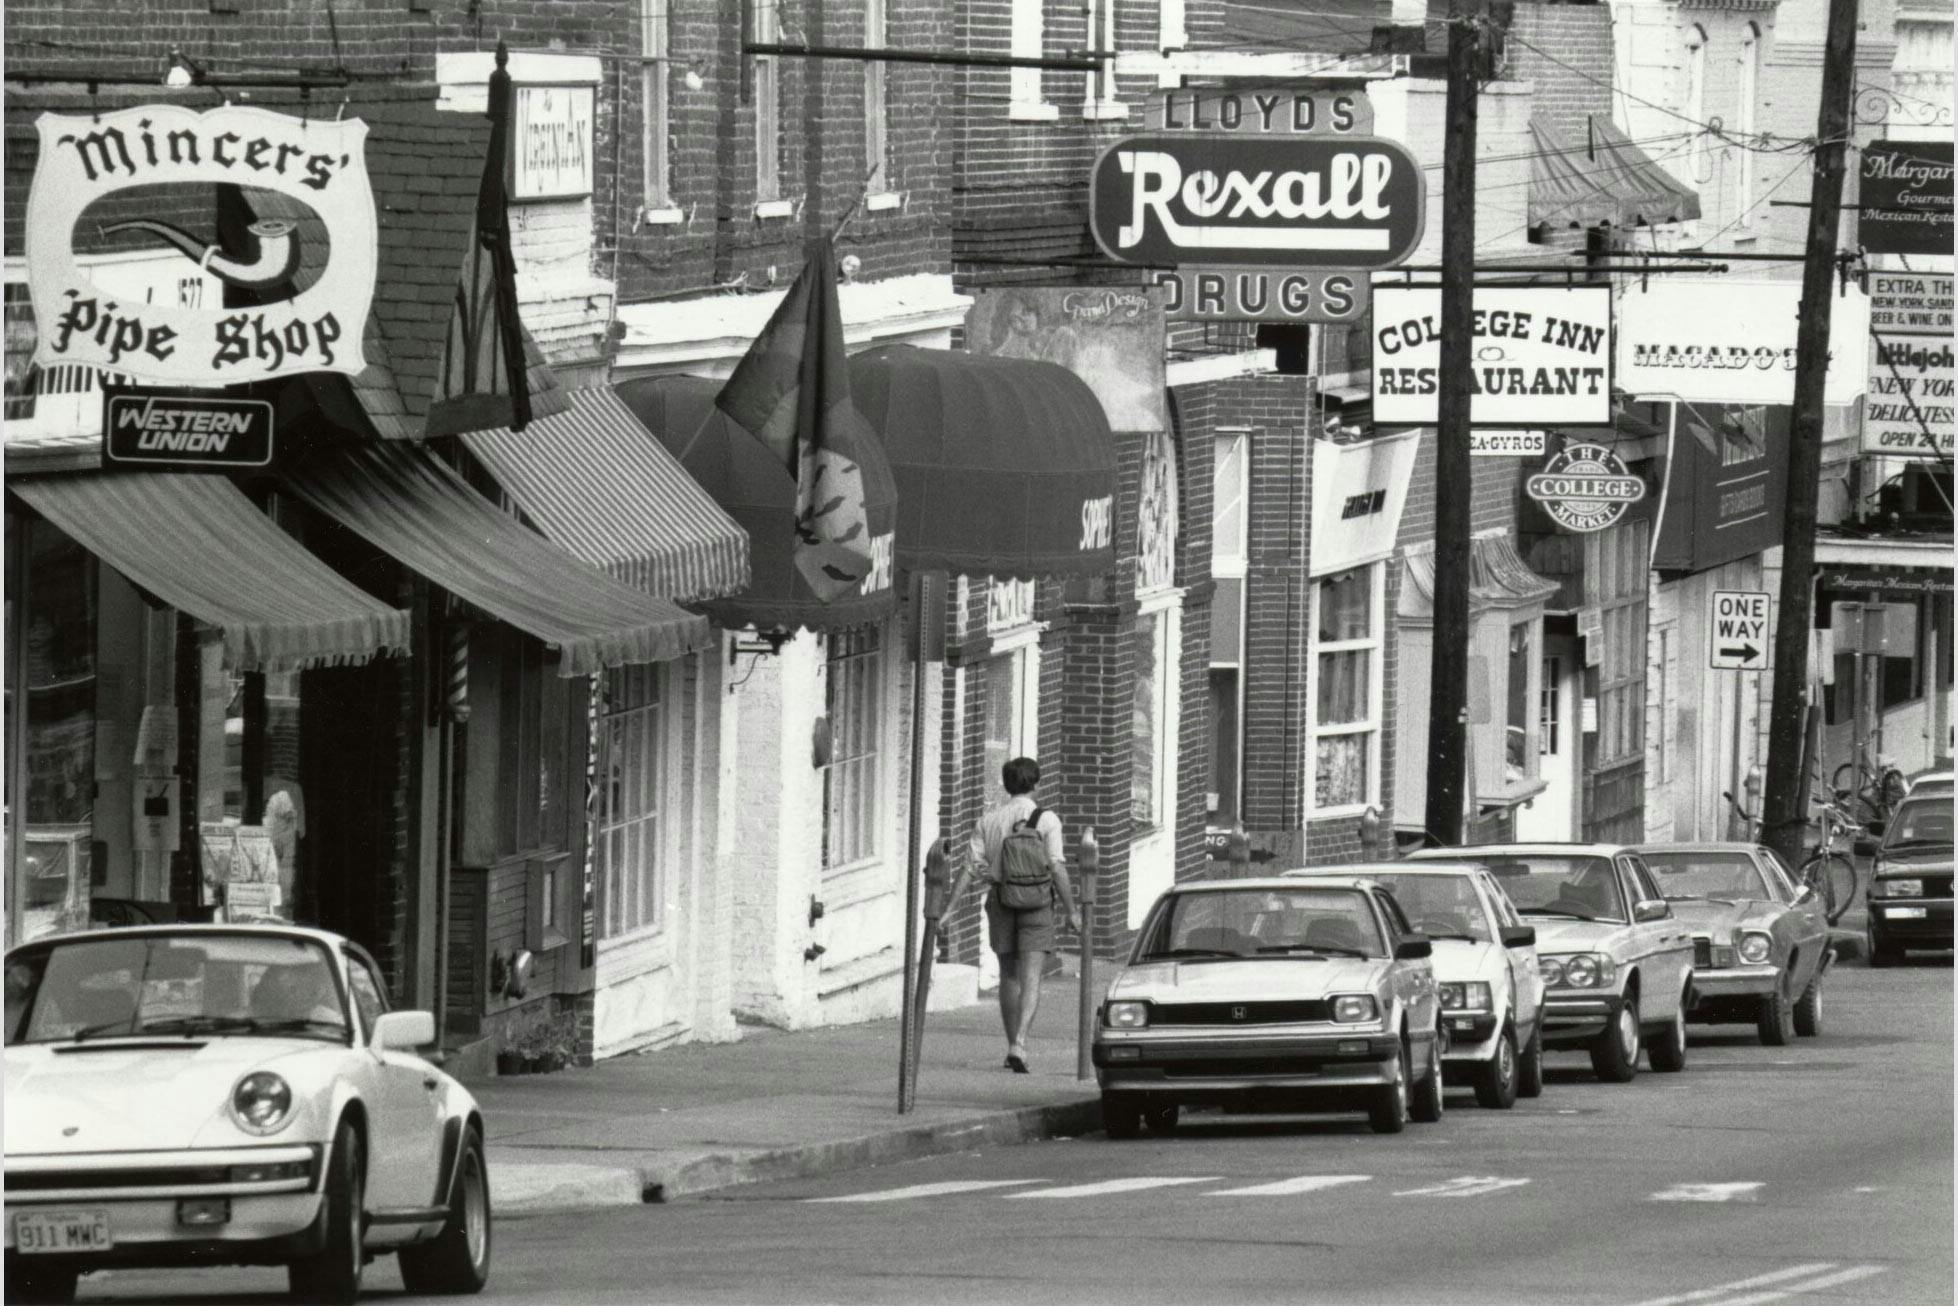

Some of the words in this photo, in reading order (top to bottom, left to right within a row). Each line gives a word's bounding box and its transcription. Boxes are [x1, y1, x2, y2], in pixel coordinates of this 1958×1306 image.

[1163, 94, 1356, 133] LLOYDS
[1117, 151, 1393, 250] Rexall
[1153, 273, 1356, 318] DRUGS
[1876, 278, 1926, 295] EXTRA
[1871, 296, 1897, 308] NEW
[50, 288, 179, 364] Pipe
[211, 311, 342, 371] Shop
[1871, 311, 1894, 325] BEER
[1897, 312, 1908, 325] &
[1908, 313, 1934, 326] WINE
[1378, 309, 1532, 355] COLEGE
[1541, 316, 1606, 355] INN
[1379, 367, 1605, 396] RESURANT
[1869, 376, 1918, 394] NEW
[118, 398, 254, 434] WESTERN
[137, 430, 230, 453] UNION
[1880, 431, 1917, 447] OPEN
[1565, 448, 1610, 466] THE
[1540, 479, 1632, 497] COLLEGE
[1555, 505, 1615, 529] MARKET
[1720, 598, 1764, 617] ONE
[1718, 620, 1765, 639] WAY
[20, 1225, 58, 1248] 911
